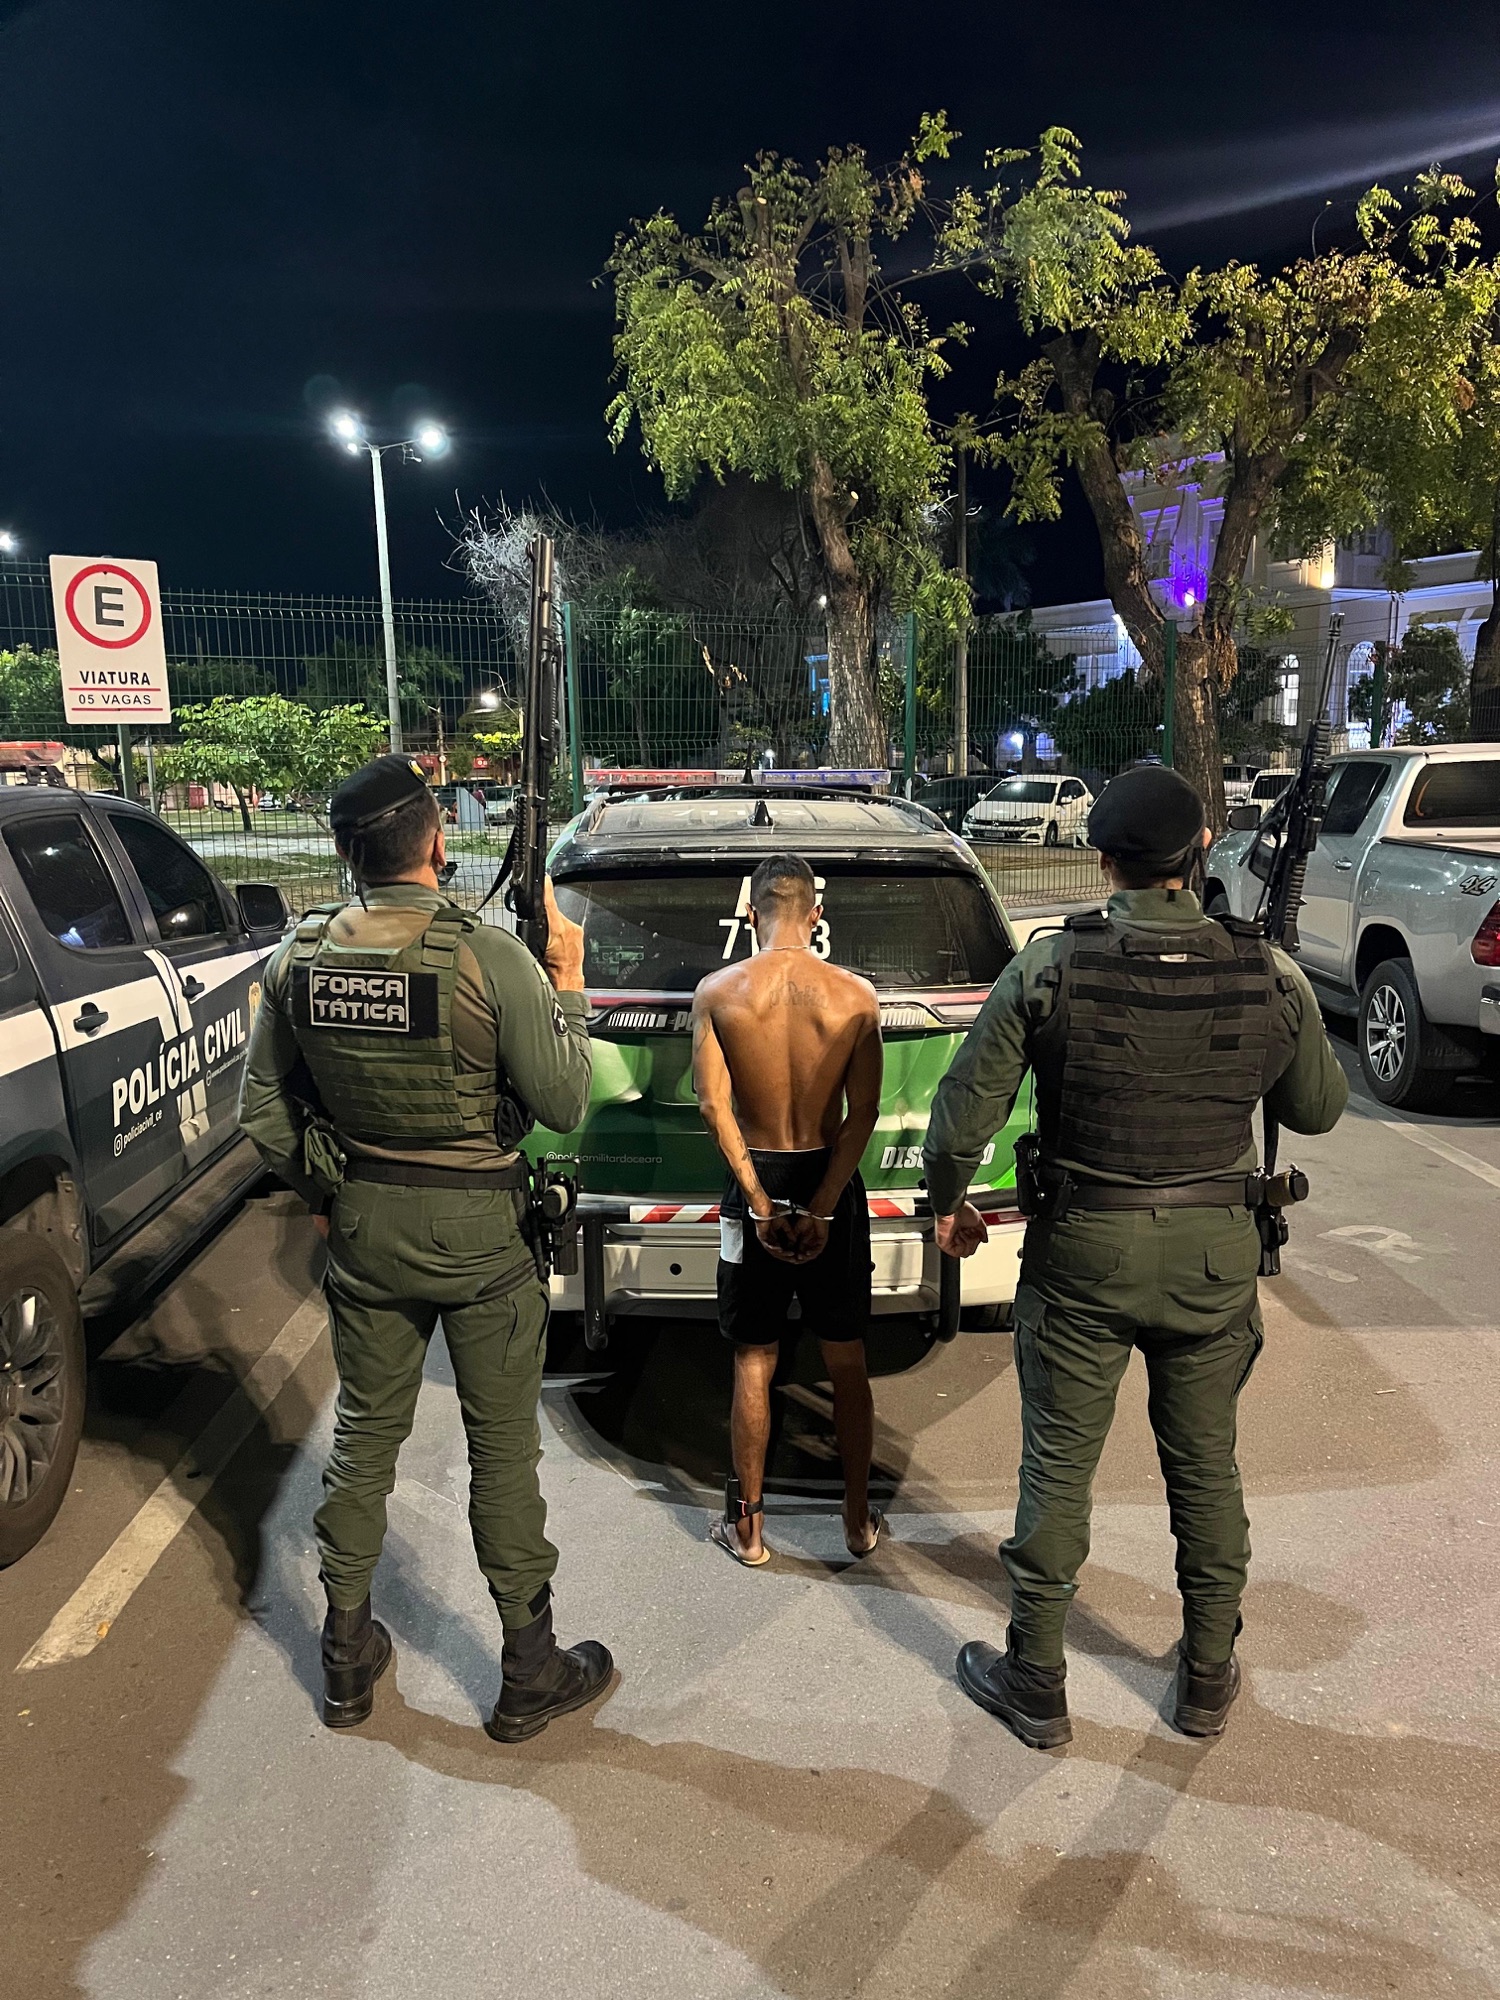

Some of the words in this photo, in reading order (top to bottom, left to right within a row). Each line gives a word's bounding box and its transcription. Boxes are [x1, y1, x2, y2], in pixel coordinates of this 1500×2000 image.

[94, 585, 124, 627] E
[79, 670, 151, 686] VIATURA
[78, 693, 95, 705] 05
[101, 694, 151, 705] VAGAS
[313, 975, 404, 998] FORÇA
[313, 998, 406, 1023] TÁTICA
[112, 1035, 200, 1128] POLÍCIA
[203, 1007, 246, 1065] CIVIL
